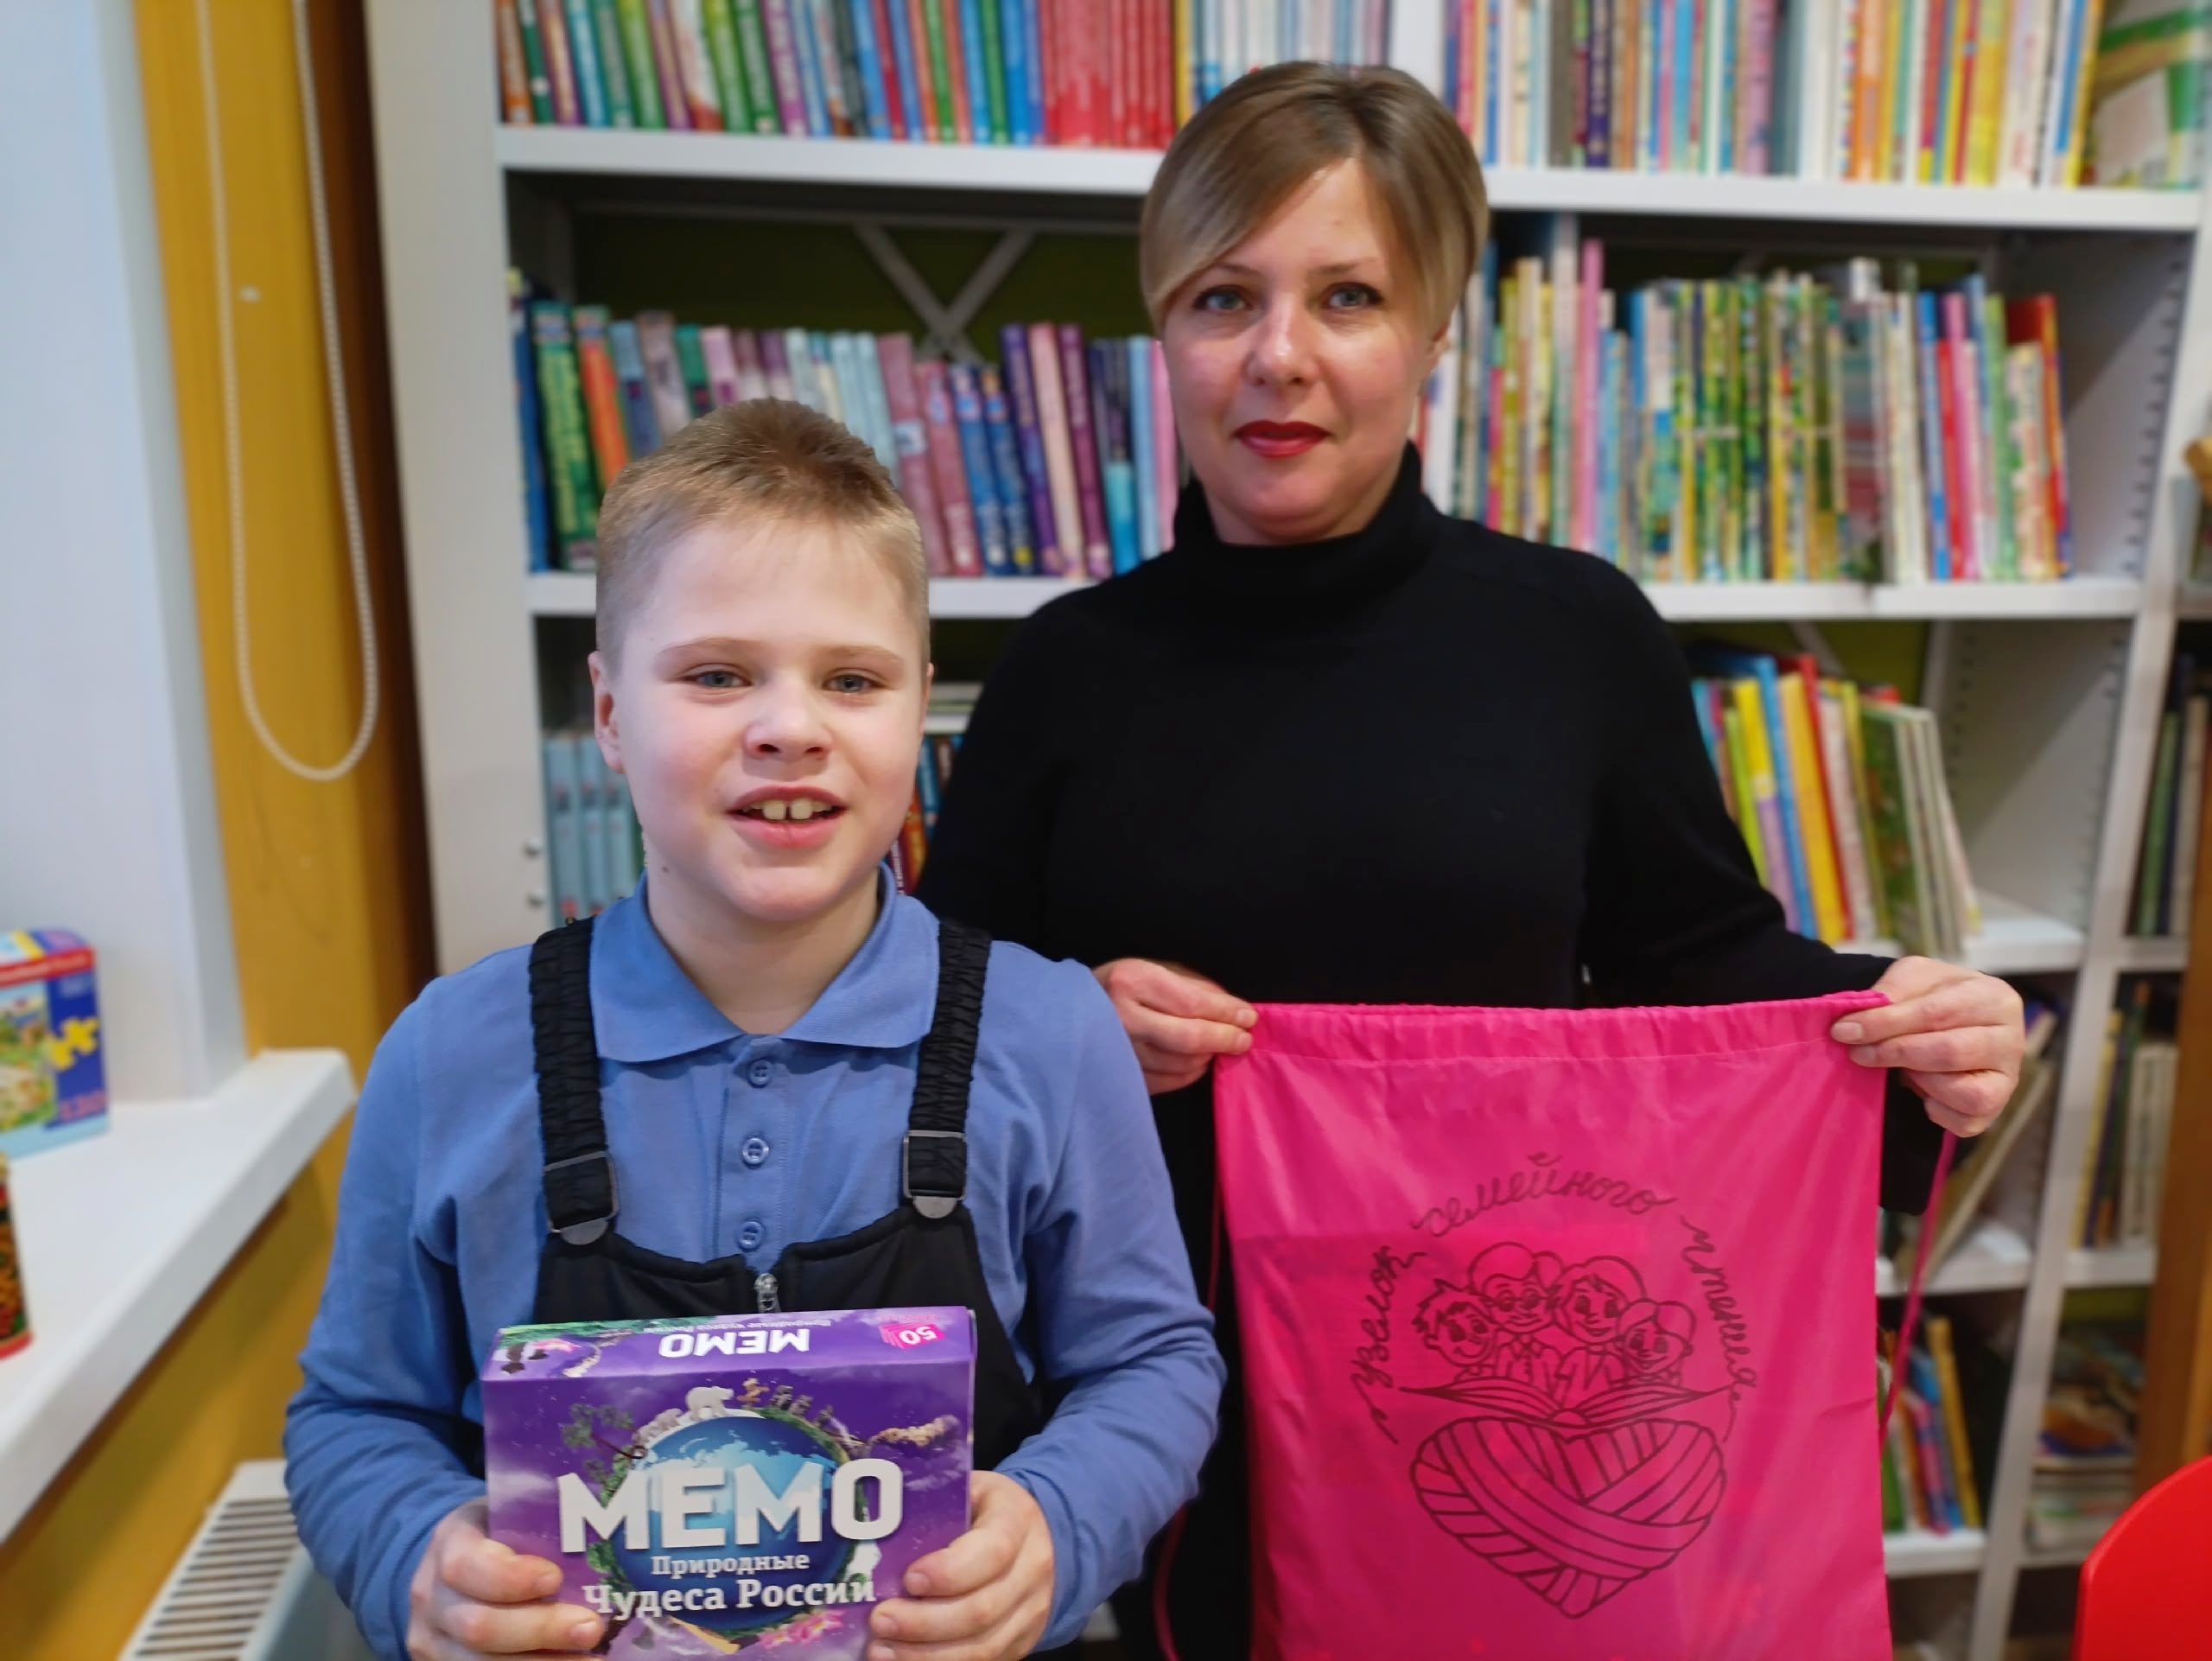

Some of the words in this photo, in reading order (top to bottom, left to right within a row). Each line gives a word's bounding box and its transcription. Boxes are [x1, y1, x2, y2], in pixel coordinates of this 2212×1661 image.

[1412, 1152, 1677, 1237] семейного
[658, 1328, 810, 1358] МЕМО
[899, 1325, 938, 1346] 50
[557, 1458, 904, 1554] МЕМО
[651, 1553, 811, 1580] Природные
[582, 1583, 728, 1621] Чудеса
[735, 1578, 877, 1609] России
